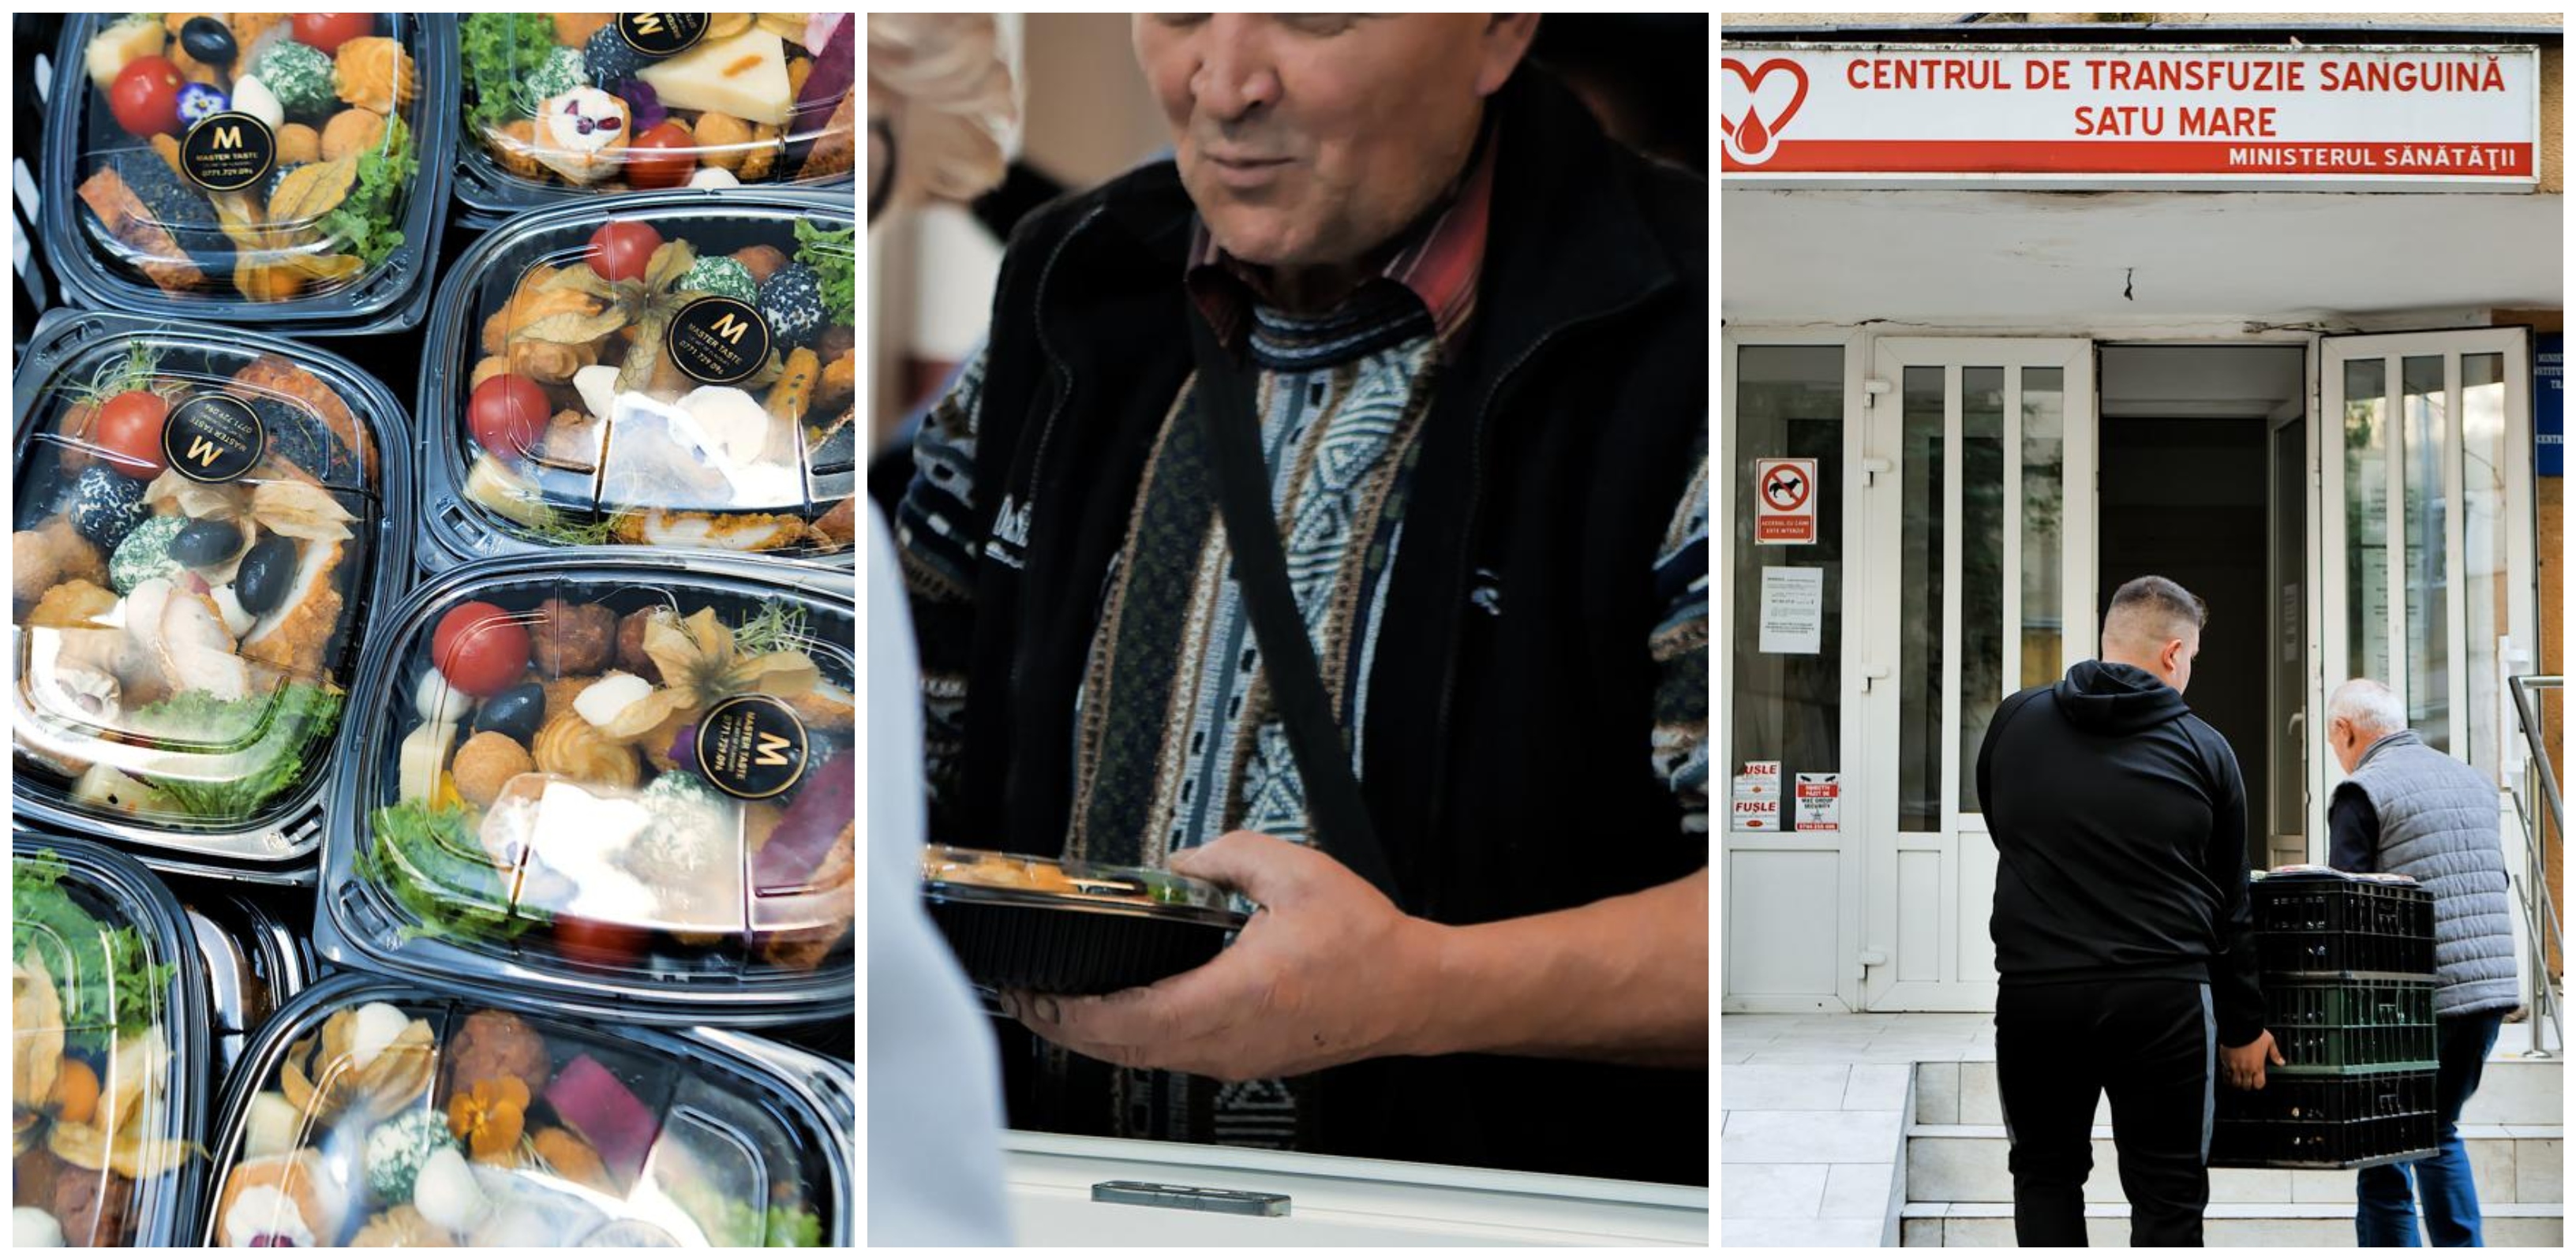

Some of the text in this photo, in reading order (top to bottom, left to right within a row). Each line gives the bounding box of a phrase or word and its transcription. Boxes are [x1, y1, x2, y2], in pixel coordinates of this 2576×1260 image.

[632, 13, 664, 36] M
[1846, 56, 2506, 92] CENTRUL DE TRANSFUZIE SANGUINĂ
[2074, 106, 2276, 137] SATU MARE
[212, 126, 243, 149] M
[2229, 147, 2376, 166] MINISTERUL
[688, 322, 719, 348] MASTER
[710, 312, 749, 346] M
[186, 435, 225, 467] M
[214, 430, 247, 453] MASTER
[736, 711, 756, 781] MASTER TASTE
[754, 731, 791, 765] M
